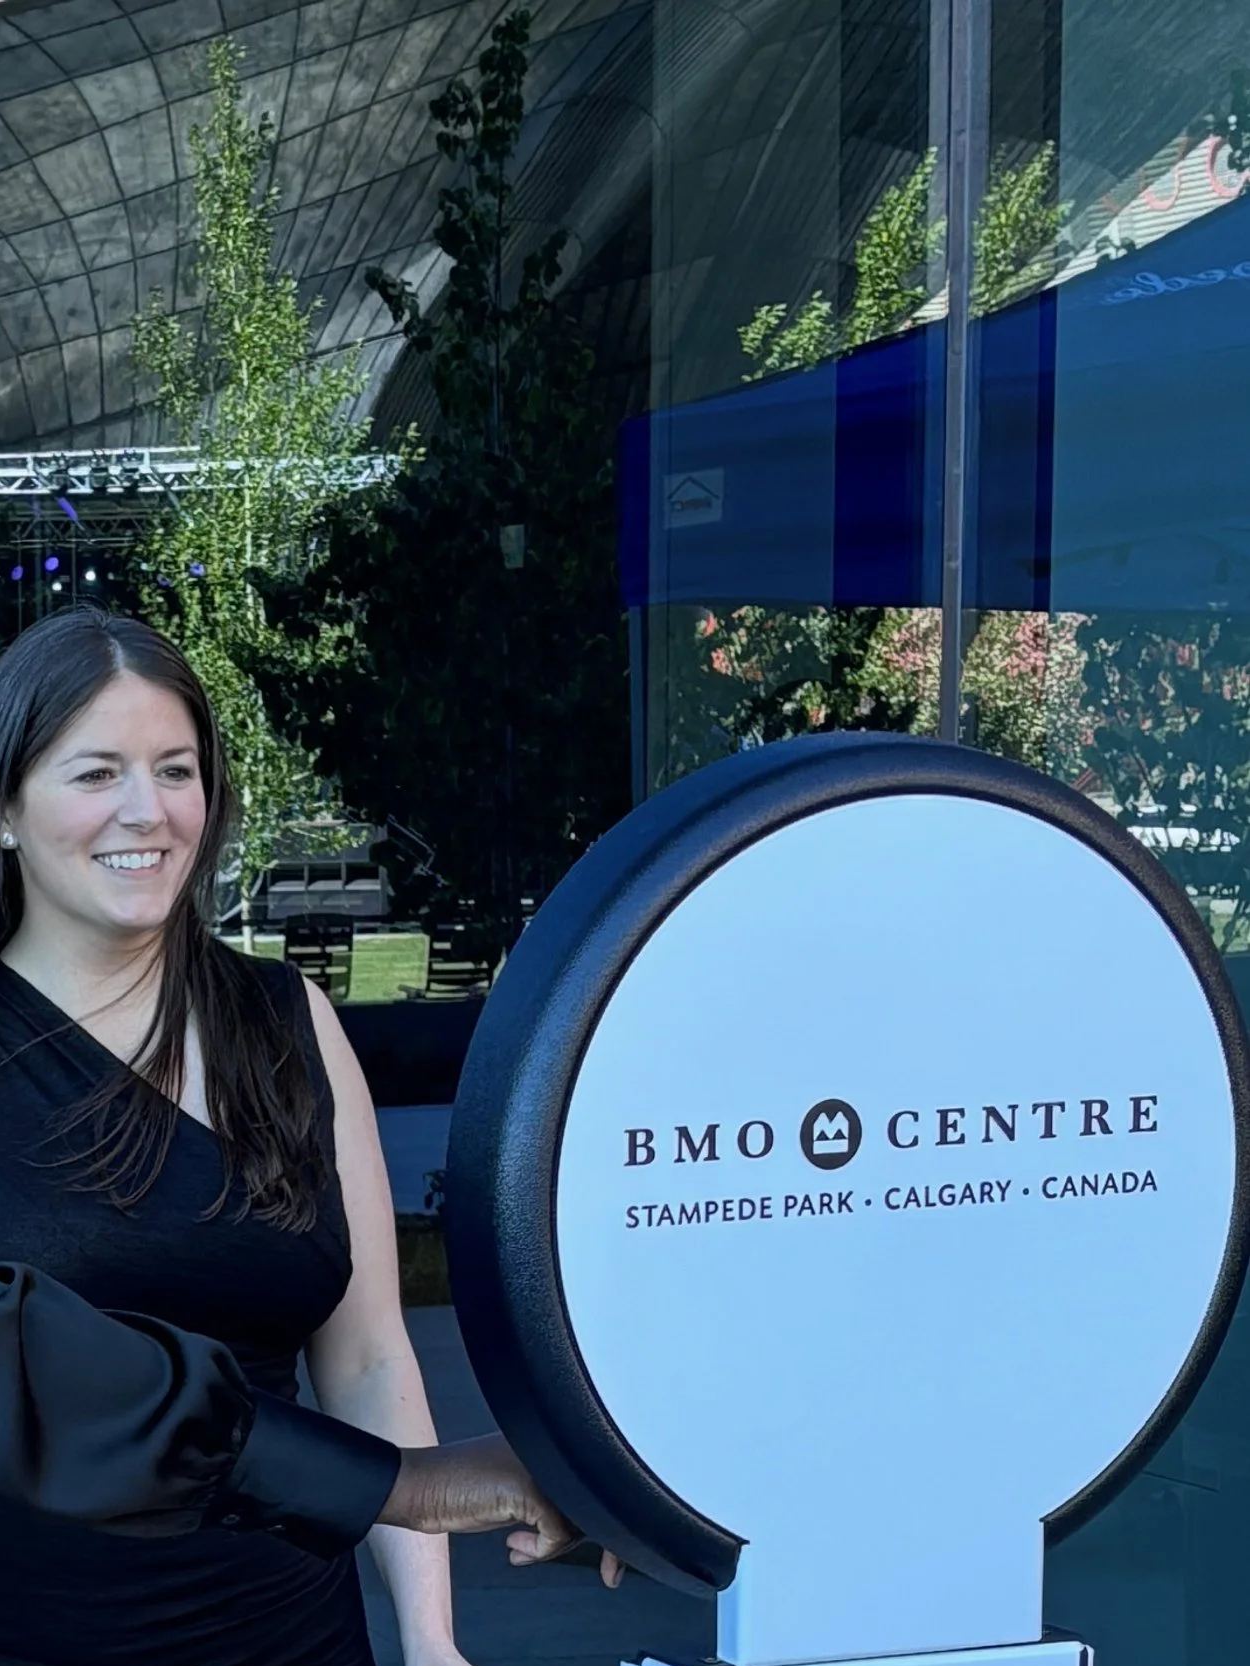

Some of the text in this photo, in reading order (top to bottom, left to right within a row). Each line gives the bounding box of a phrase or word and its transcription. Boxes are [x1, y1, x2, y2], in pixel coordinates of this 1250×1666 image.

[623, 1095, 1159, 1167] BMO CENTRE
[625, 1169, 1158, 1229] STAMPEDE PARK CALGARY CANADA
